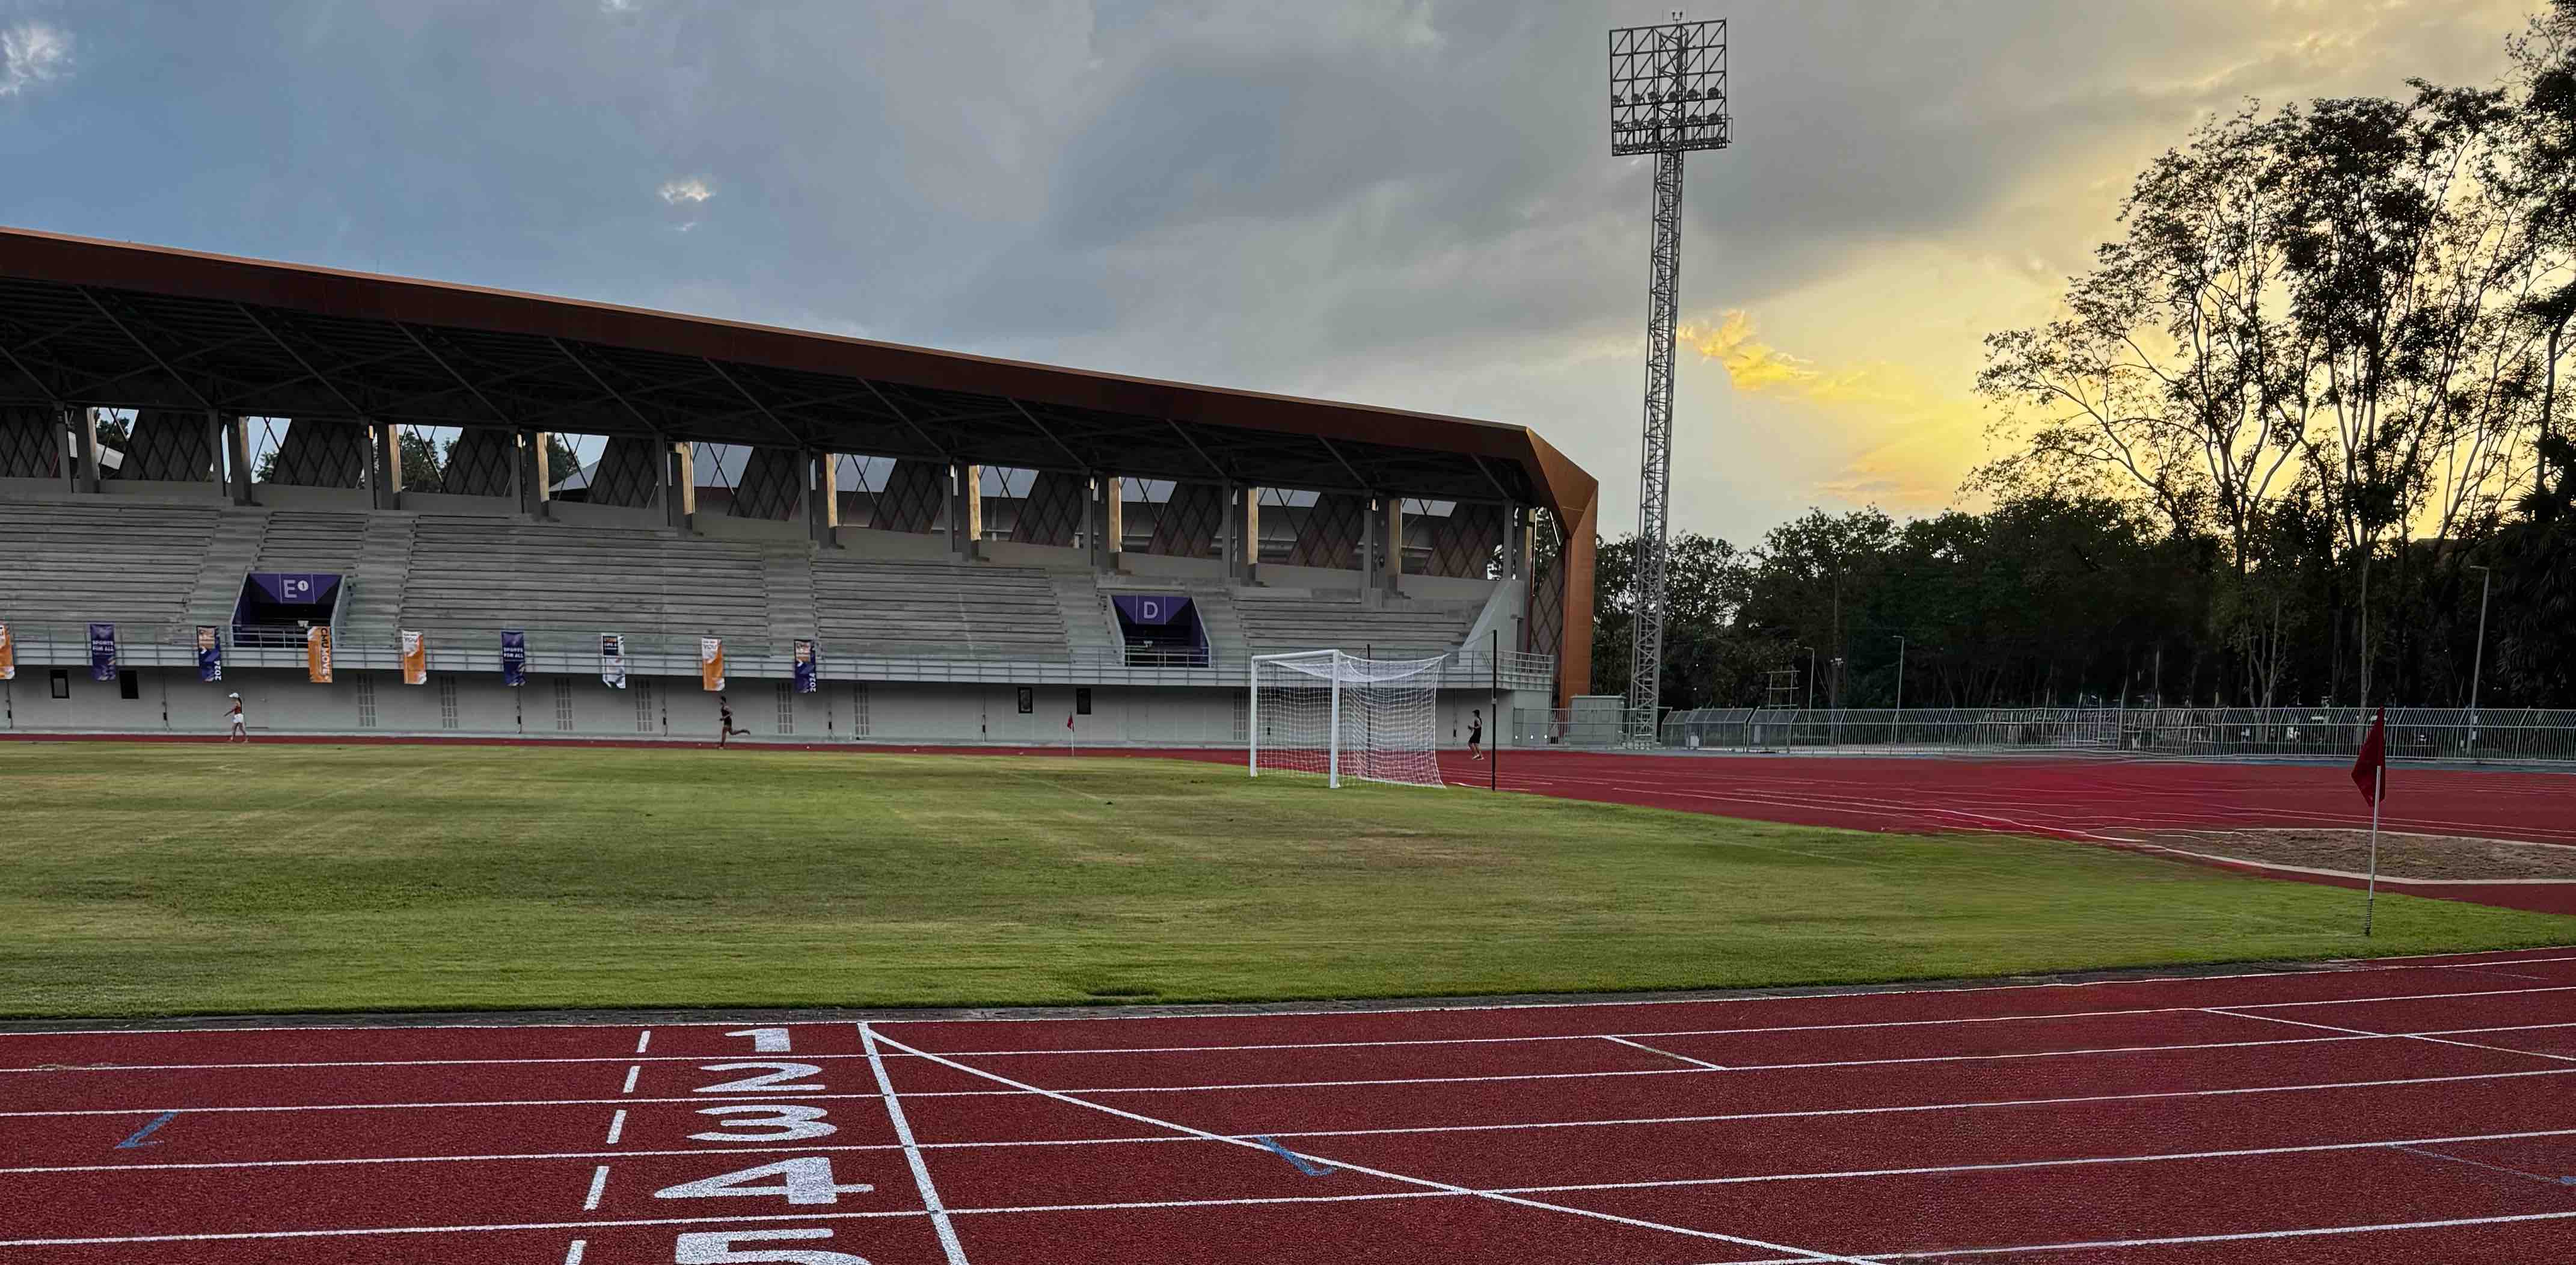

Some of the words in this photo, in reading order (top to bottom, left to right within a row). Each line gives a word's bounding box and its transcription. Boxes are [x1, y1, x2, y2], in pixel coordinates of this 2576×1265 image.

[283, 579, 297, 598] E
[1143, 602, 1158, 619] D
[213, 660, 222, 680] 2024
[725, 1028, 791, 1052] 1
[692, 1062, 826, 1093] 2
[686, 1104, 838, 1142] 3
[654, 1157, 874, 1204] 4
